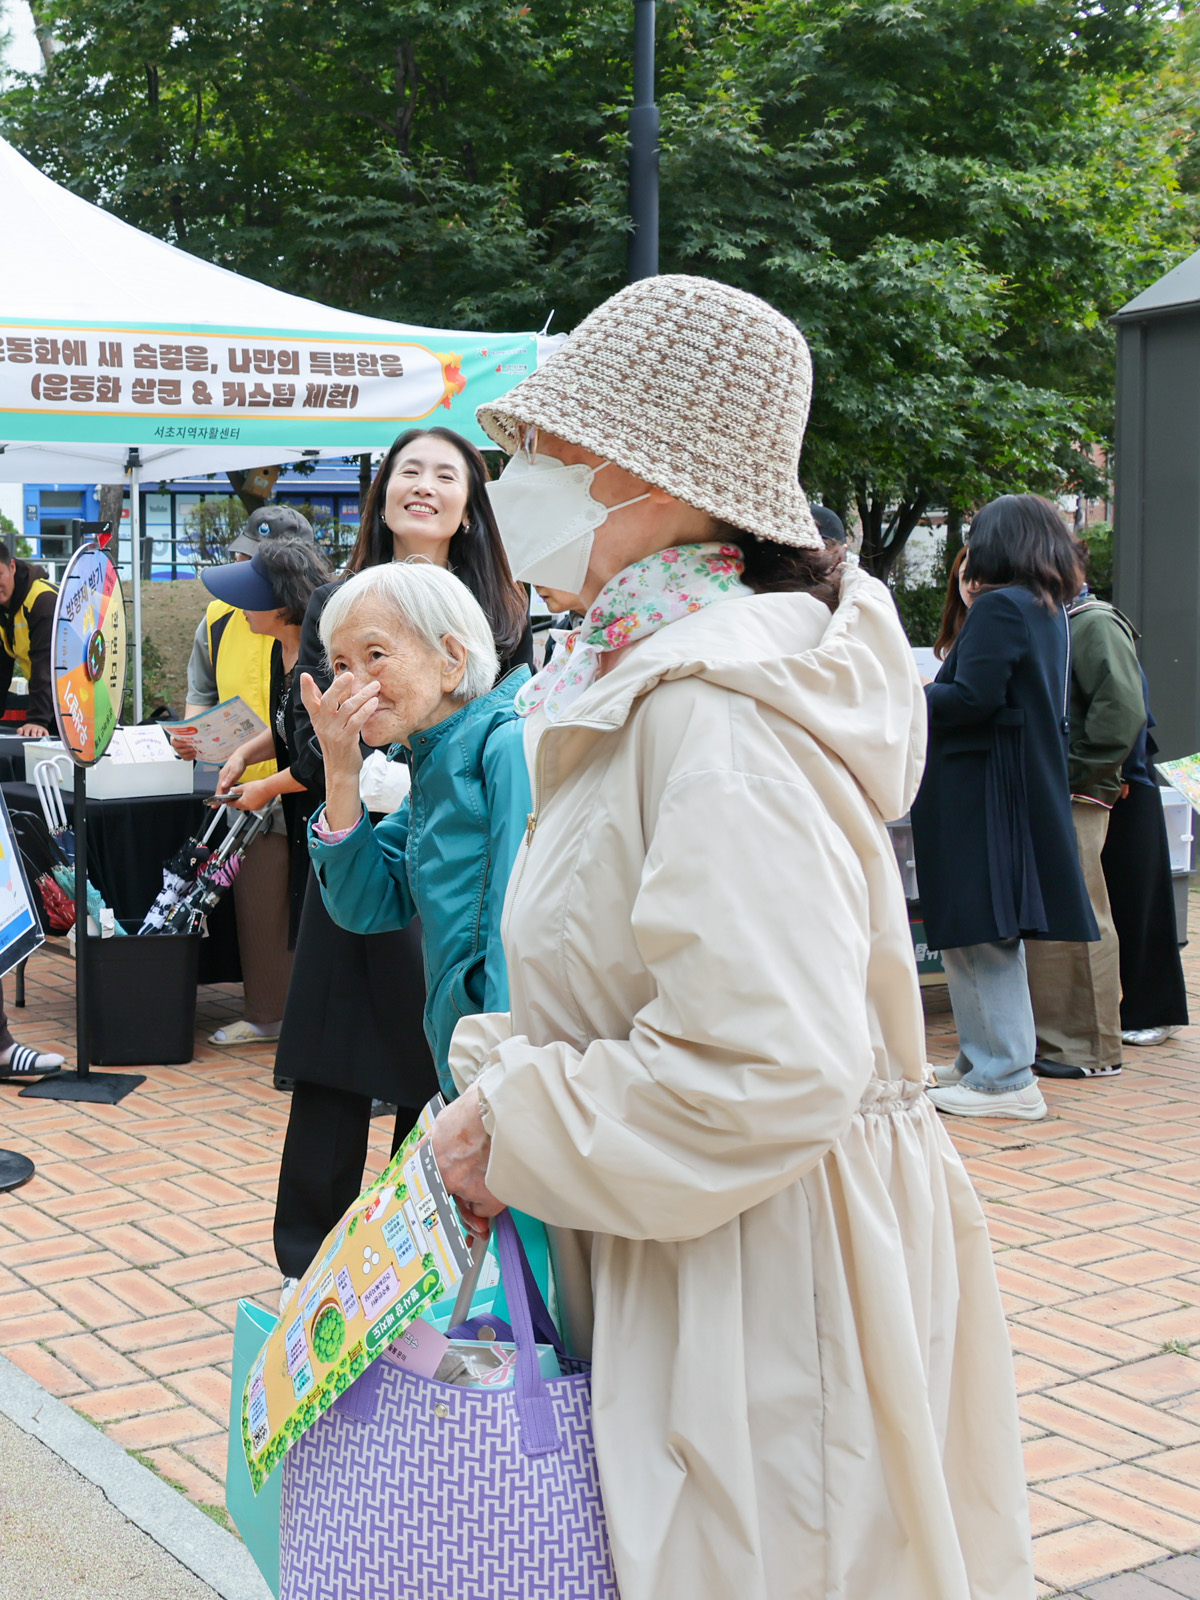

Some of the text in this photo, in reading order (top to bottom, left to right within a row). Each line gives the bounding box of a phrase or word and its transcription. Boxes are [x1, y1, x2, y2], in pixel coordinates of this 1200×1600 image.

[98, 341, 123, 368] 새
[133, 343, 218, 374] 숨결을,
[228, 347, 300, 375] 나만의
[309, 351, 404, 378] 특별함을
[30, 373, 359, 409] (운동화 살균 & 커스텀 체험)
[153, 425, 240, 440] 서초지역자활센터
[66, 562, 104, 622] 방향제 받기
[370, 1284, 391, 1308] 동주민센터
[371, 1313, 395, 1340] 배치도
[404, 1332, 419, 1349] 접수
